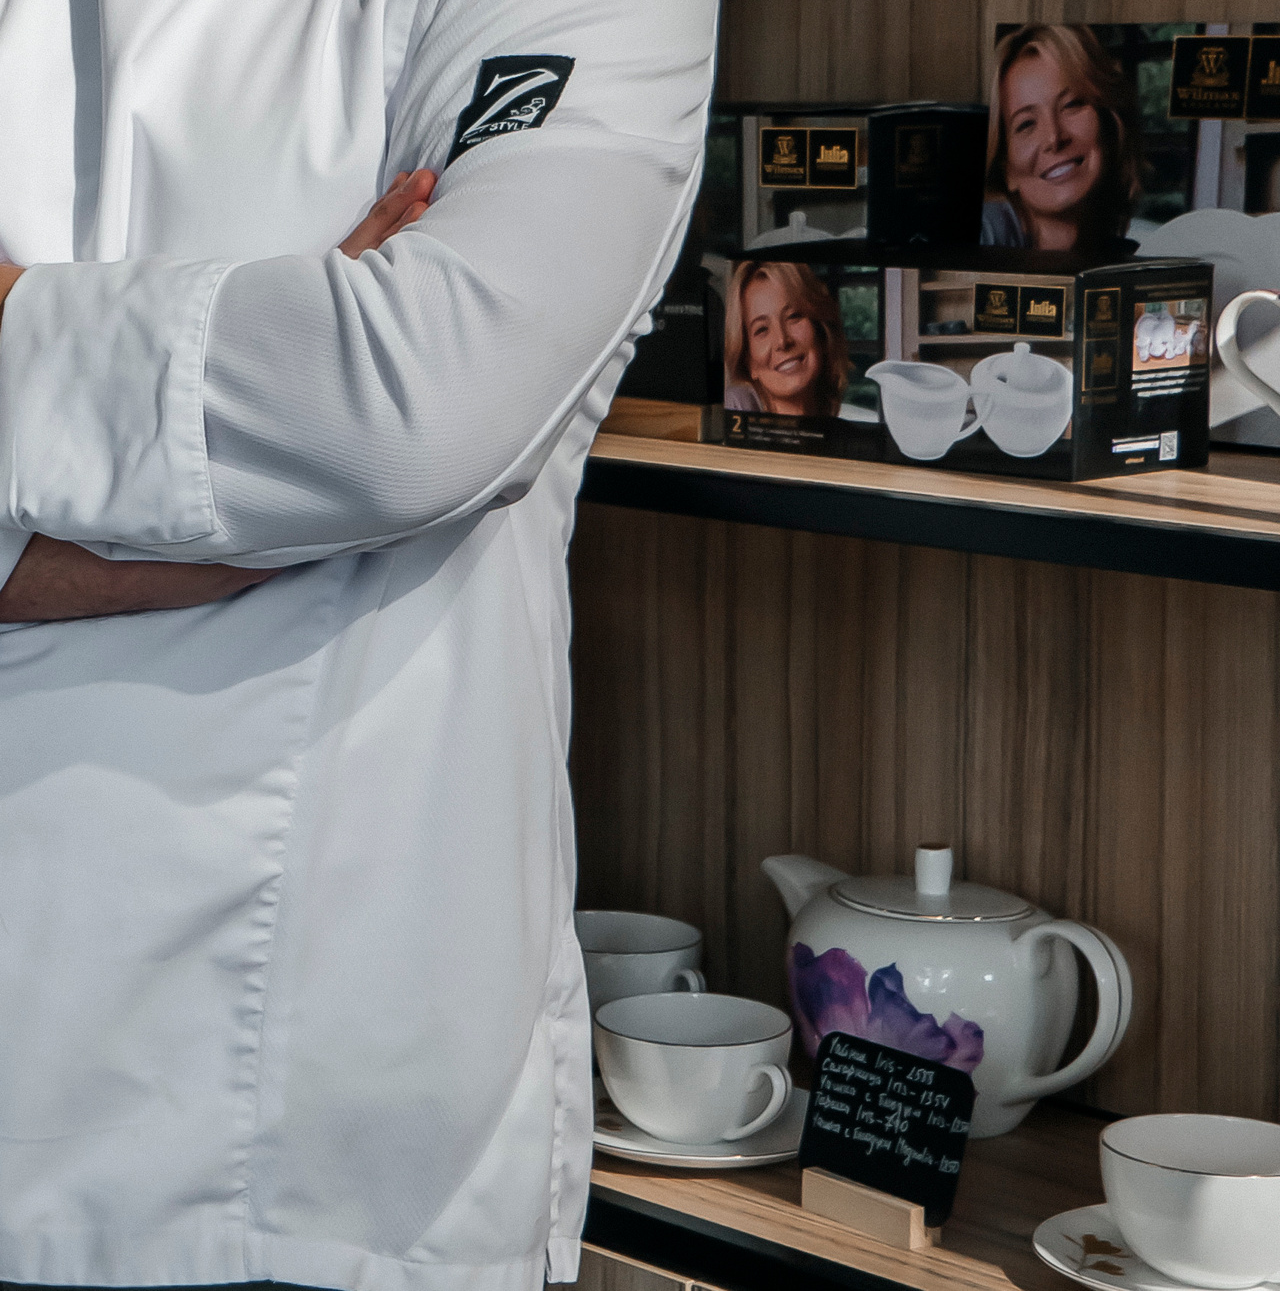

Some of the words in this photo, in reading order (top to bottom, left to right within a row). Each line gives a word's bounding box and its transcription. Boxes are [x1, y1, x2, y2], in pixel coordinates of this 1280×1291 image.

[1177, 87, 1239, 101] Wilmax
[489, 120, 530, 132] STYLE
[732, 415, 742, 432] 2
